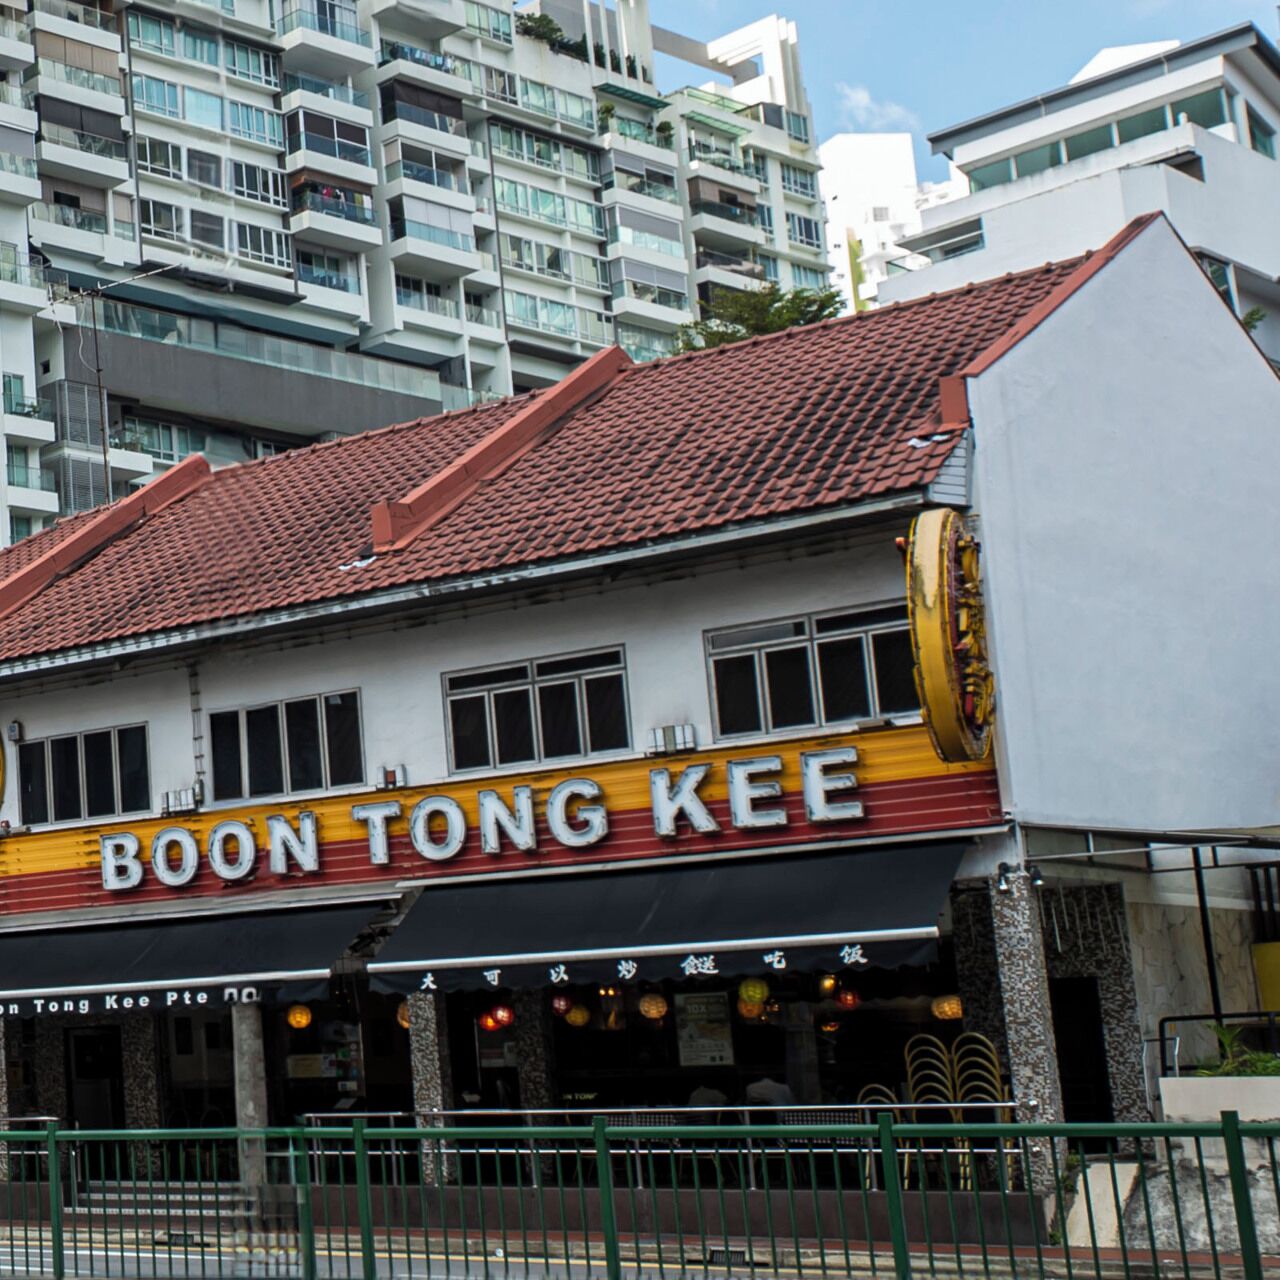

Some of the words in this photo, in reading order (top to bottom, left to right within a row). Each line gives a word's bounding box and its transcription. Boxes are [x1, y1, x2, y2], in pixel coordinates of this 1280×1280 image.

[100, 810, 320, 892] BOON
[351, 778, 609, 866] TONG
[649, 746, 866, 840] KEE
[34, 999, 89, 1013] Tong
[105, 995, 150, 1010] Kee
[167, 991, 208, 1006] Pte
